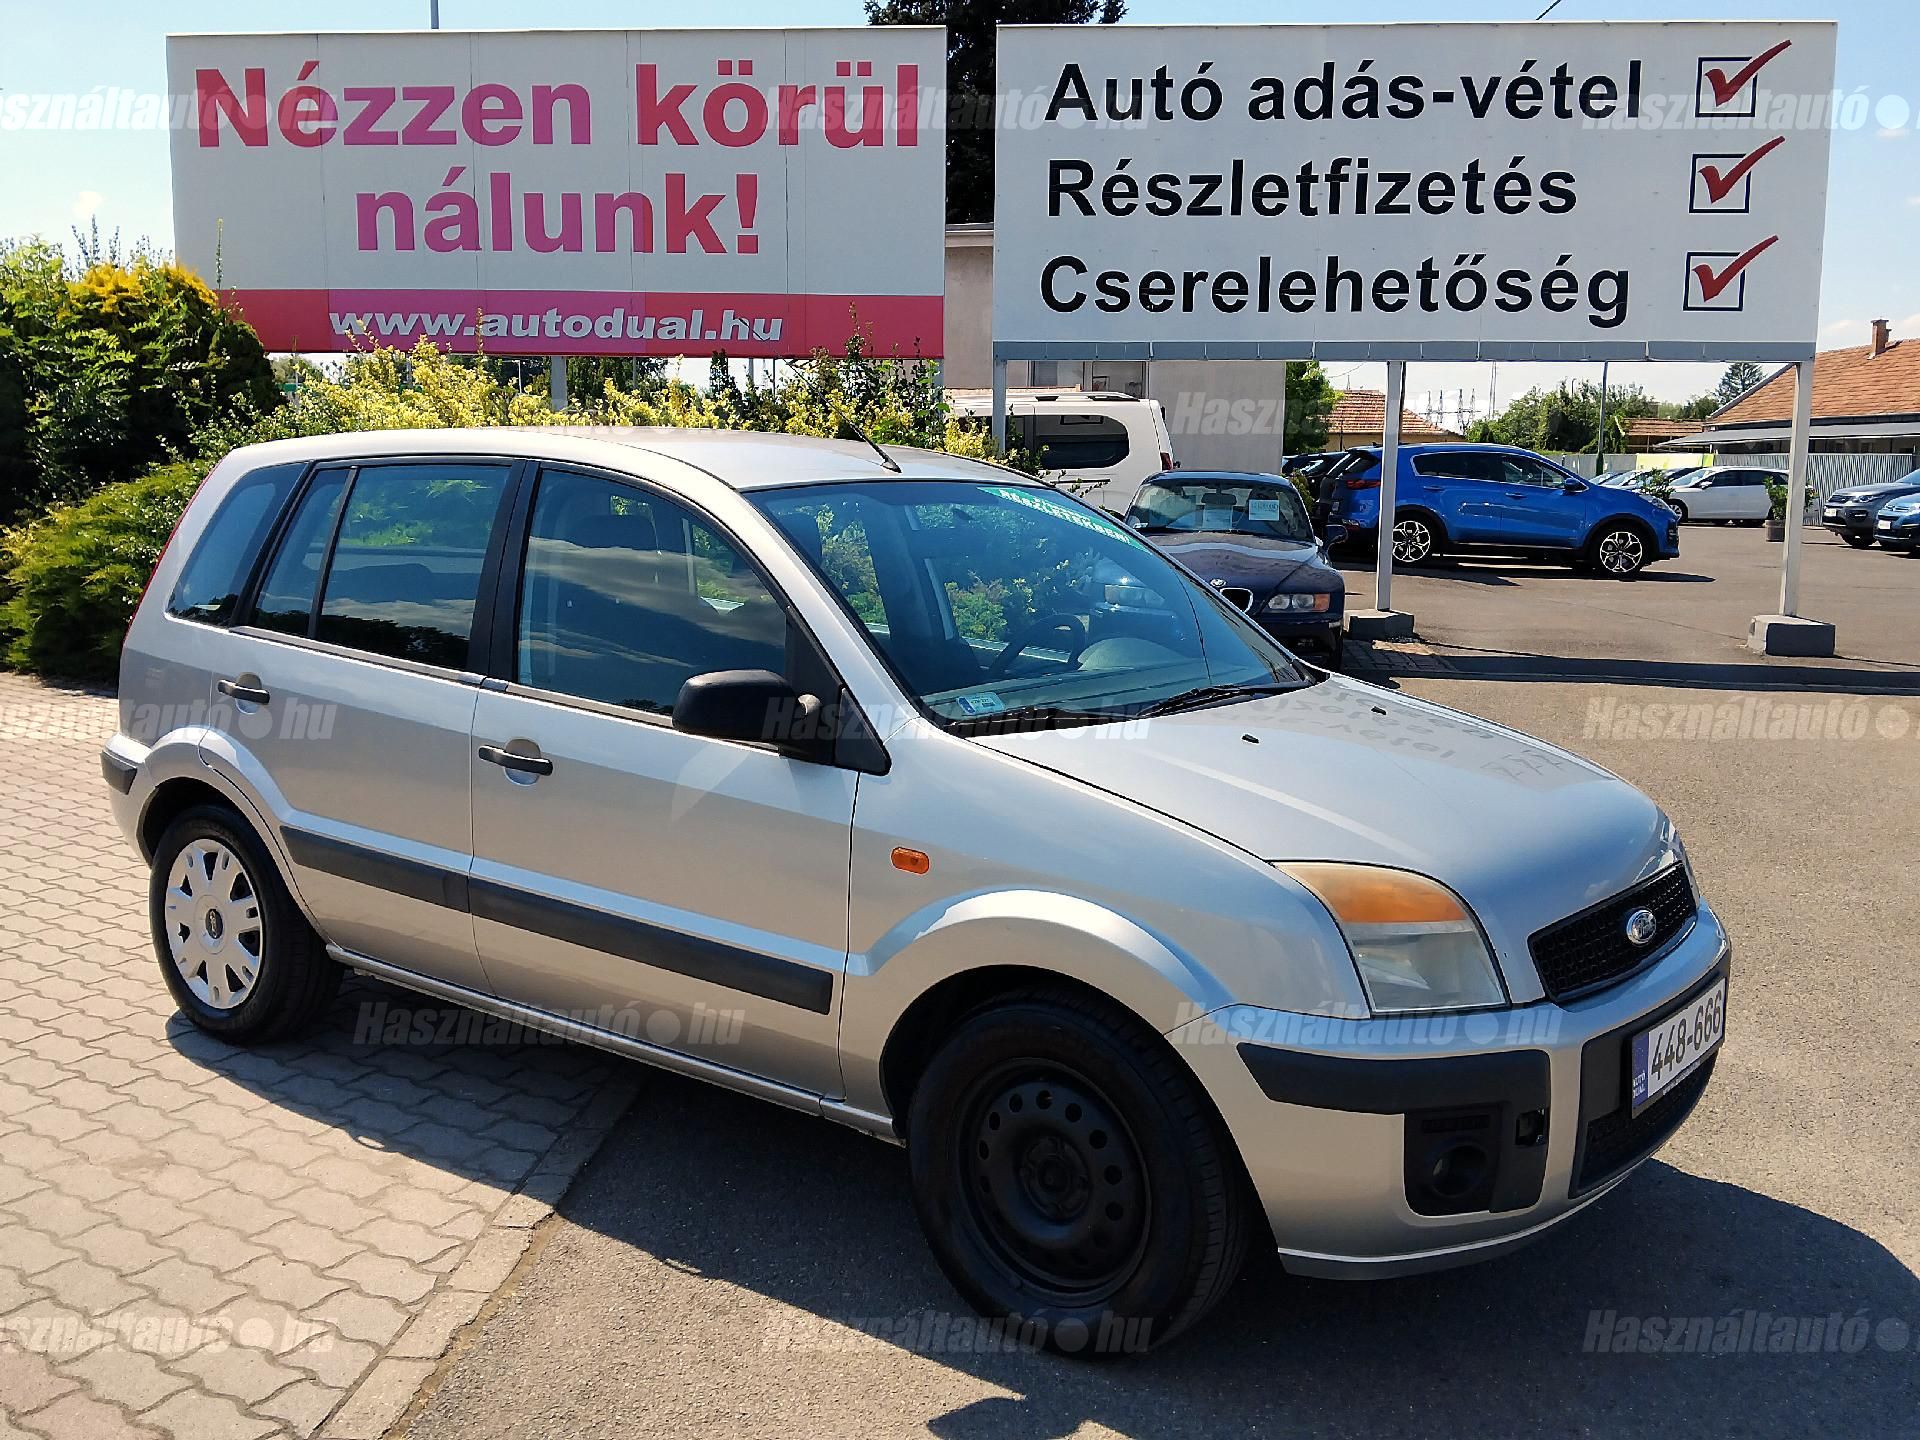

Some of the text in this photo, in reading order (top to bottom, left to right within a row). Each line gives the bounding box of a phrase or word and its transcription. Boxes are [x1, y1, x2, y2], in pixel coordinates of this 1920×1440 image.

[197, 61, 918, 148] Nézzen körül
[1045, 60, 1641, 121] Autó adás-vétel
[358, 169, 759, 254] nálunk!
[1049, 156, 1577, 217] Részletfizetés
[329, 308, 783, 341] www.autodual.hu
[1041, 254, 1629, 328] Cserelehetőség
[1651, 989, 1722, 1081] 448-666
